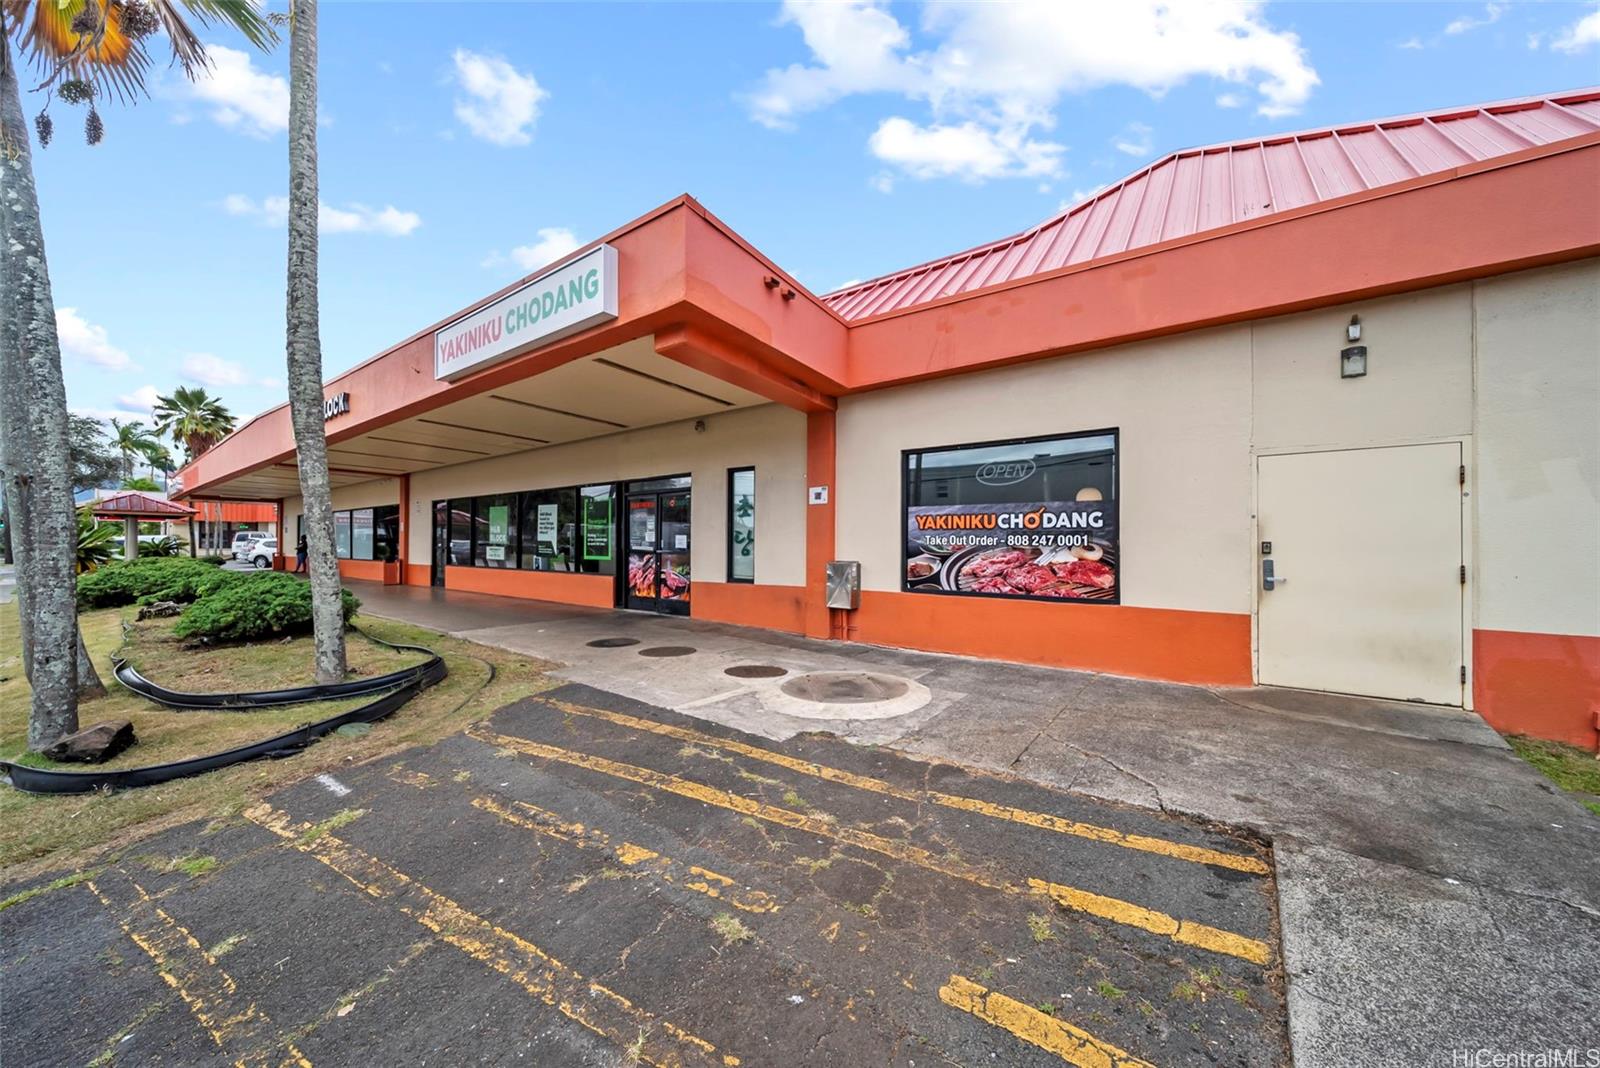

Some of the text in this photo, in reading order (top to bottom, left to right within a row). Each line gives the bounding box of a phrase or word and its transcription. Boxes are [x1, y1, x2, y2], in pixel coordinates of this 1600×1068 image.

[439, 268, 600, 364] YAKINIKU CHODANG
[983, 464, 1027, 478] OPEN
[916, 507, 1104, 530] YAKINIKU CHODANG
[925, 535, 948, 546] Take
[949, 535, 967, 546] Out
[968, 535, 998, 546] Order
[1007, 534, 1029, 546] 808
[1031, 534, 1055, 546] 247
[1057, 534, 1089, 546] 0001
